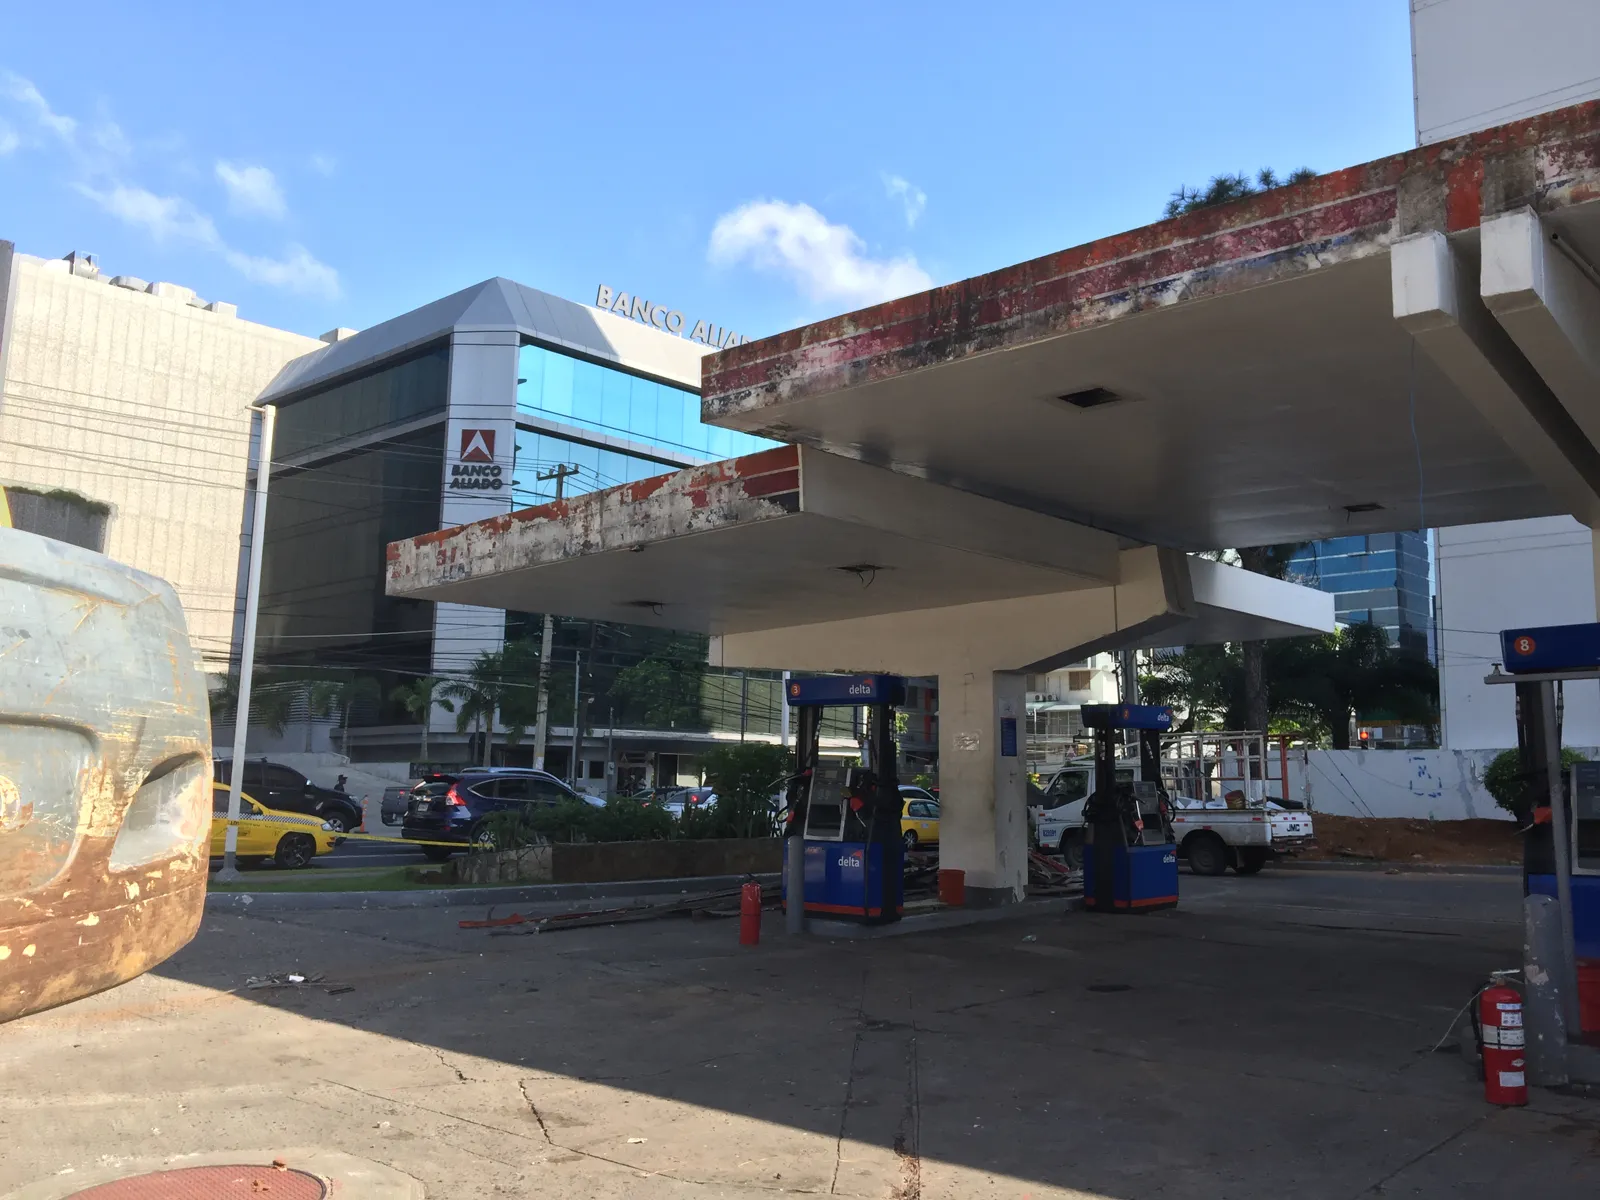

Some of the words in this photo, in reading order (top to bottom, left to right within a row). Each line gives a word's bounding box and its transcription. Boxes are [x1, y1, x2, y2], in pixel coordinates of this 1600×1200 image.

[596, 284, 685, 333] BANCO
[451, 465, 501, 477] BANCO
[450, 478, 503, 490] ALIADO
[1520, 639, 1529, 651] 8
[793, 686, 798, 694] 3
[849, 684, 871, 695] delta
[1157, 712, 1169, 722] delta
[1286, 823, 1300, 832] JMC
[838, 856, 860, 868] delta
[1163, 853, 1175, 863] delta
